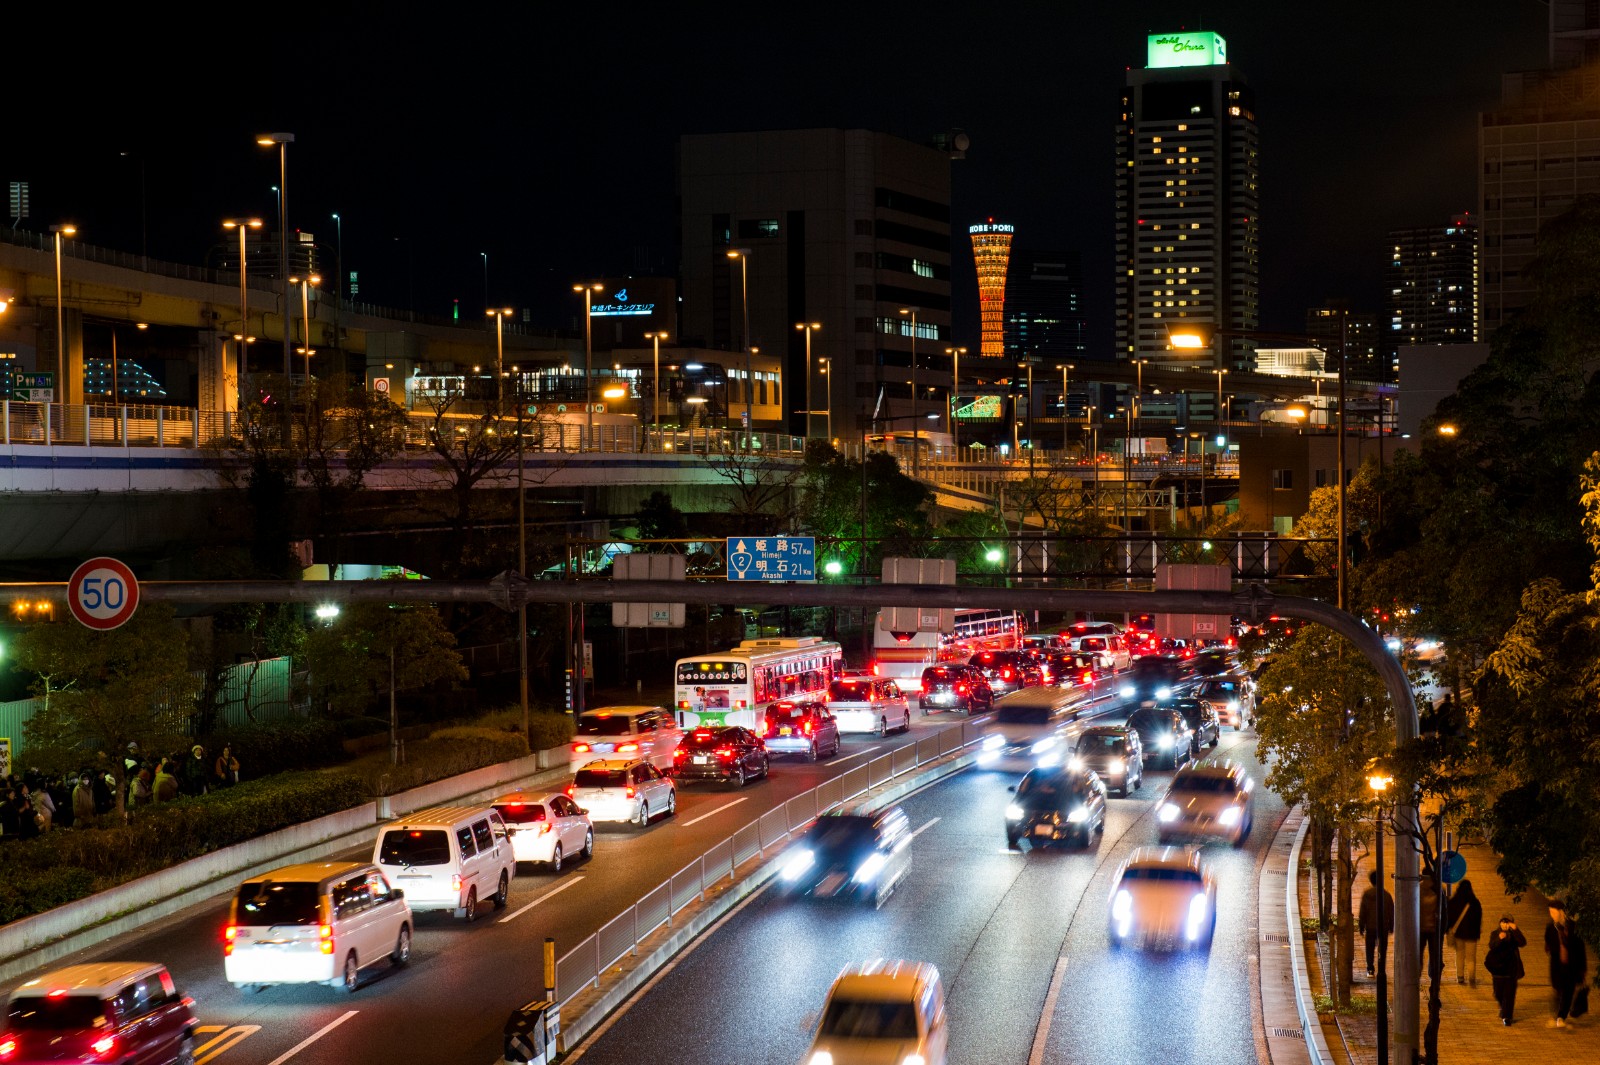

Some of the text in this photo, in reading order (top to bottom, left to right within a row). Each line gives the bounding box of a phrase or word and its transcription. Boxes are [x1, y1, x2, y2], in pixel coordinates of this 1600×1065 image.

[1173, 39, 1205, 52] Okura
[16, 374, 24, 387] P
[756, 540, 788, 552] 姫路
[738, 556, 745, 567] 2
[761, 552, 783, 560] Himeji
[756, 560, 789, 572] 明石
[83, 578, 123, 610] 50
